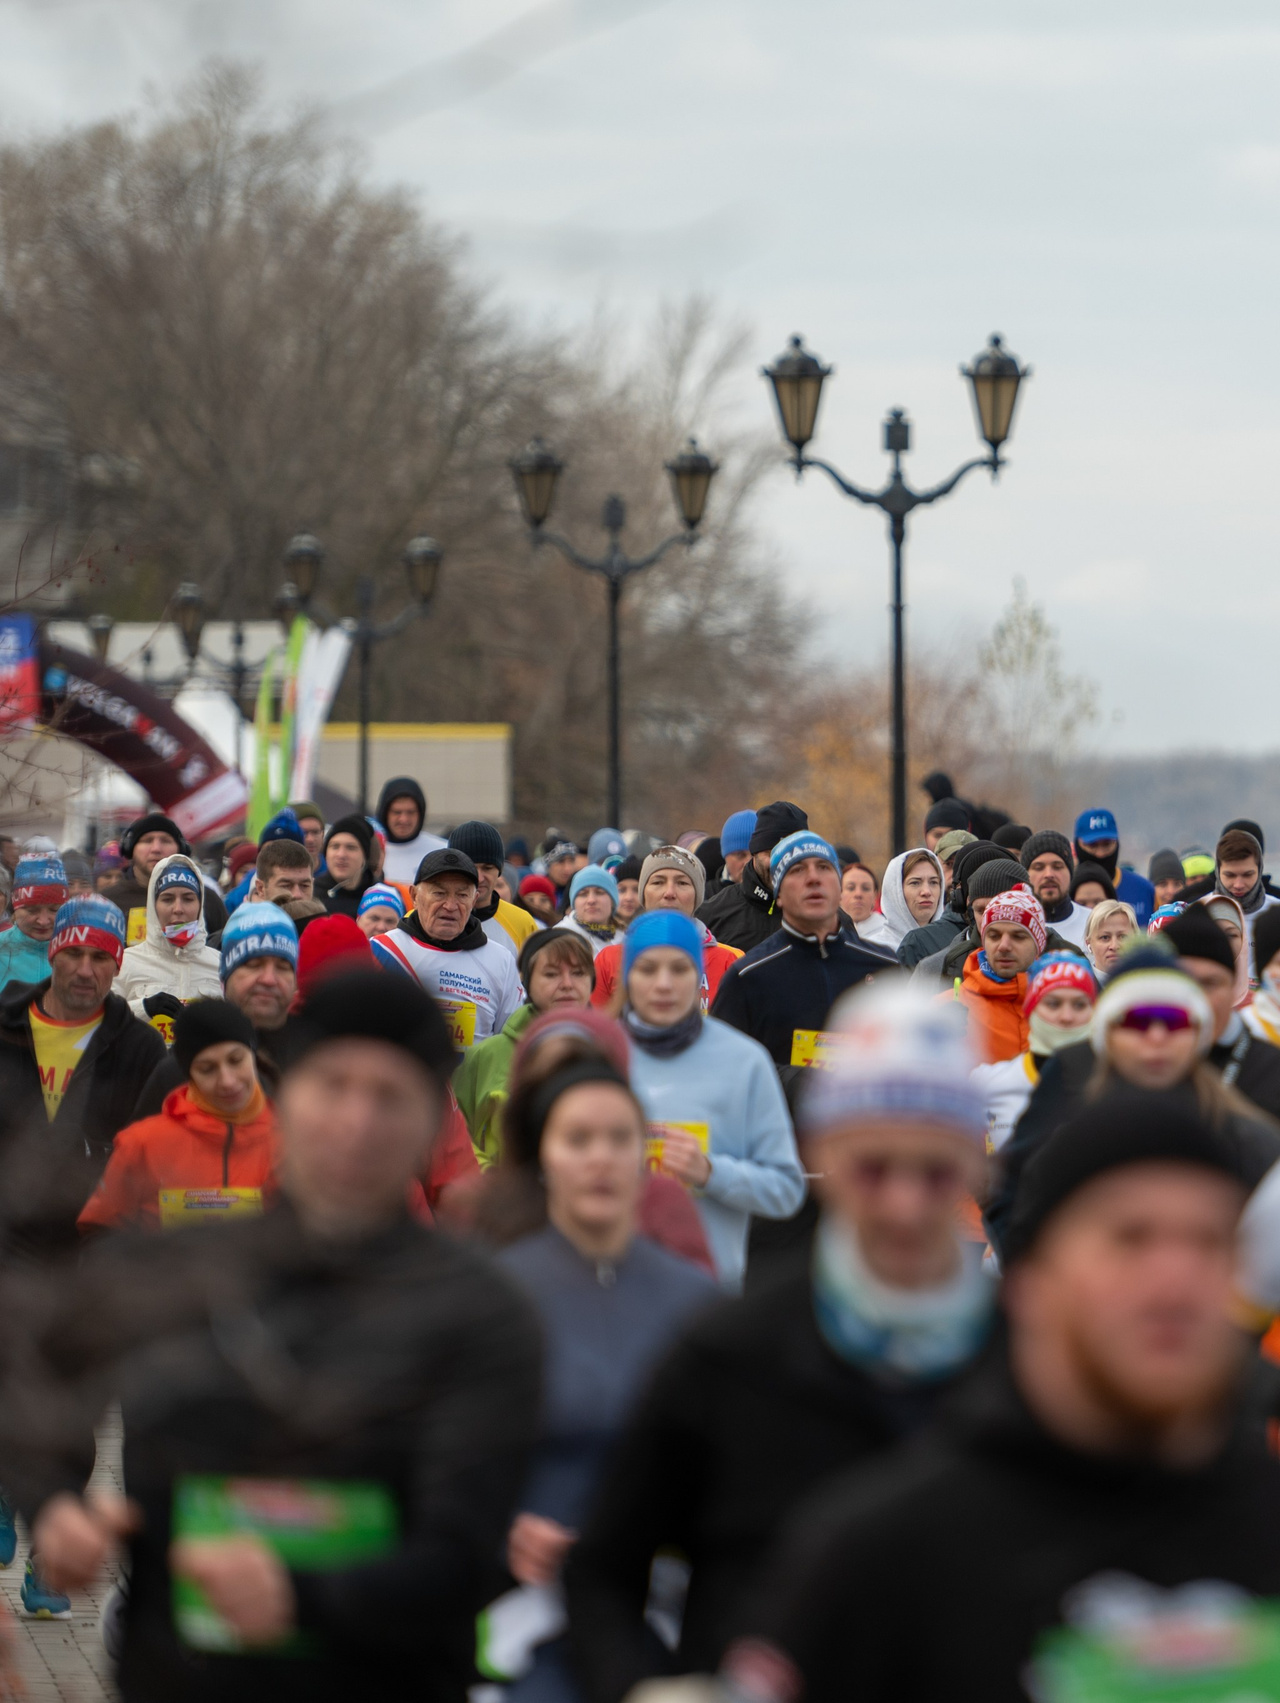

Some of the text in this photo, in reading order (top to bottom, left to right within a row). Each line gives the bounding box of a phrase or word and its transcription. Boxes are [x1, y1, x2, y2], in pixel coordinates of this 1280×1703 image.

[772, 846, 803, 888] ULTRA
[51, 926, 89, 952] RUN
[225, 931, 274, 968] ULTRA
[439, 970, 482, 986] САМАРСКИЙ
[439, 978, 491, 996] ПОЛУМАРАФОН
[1031, 962, 1085, 994] RUN
